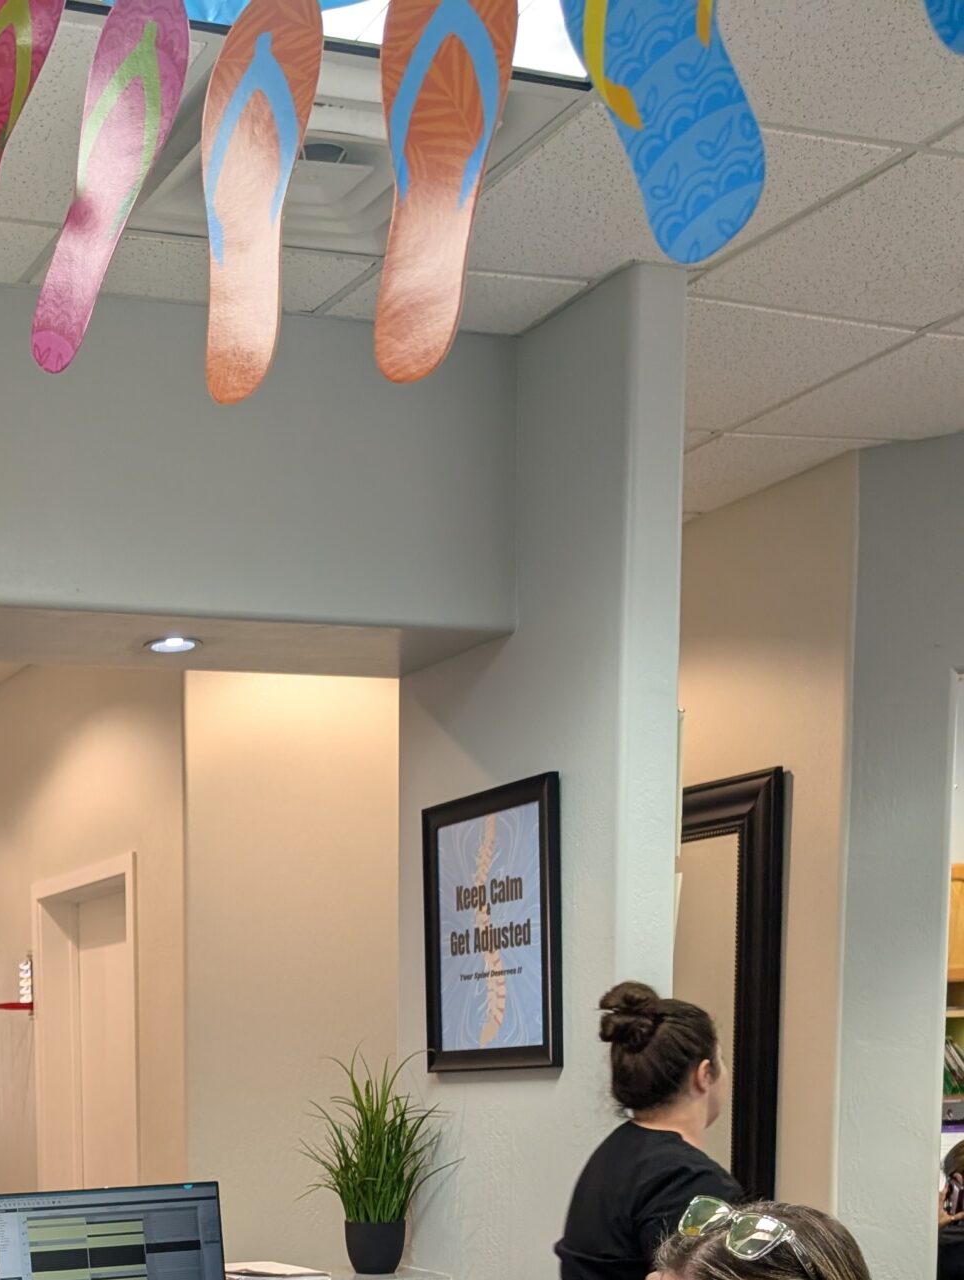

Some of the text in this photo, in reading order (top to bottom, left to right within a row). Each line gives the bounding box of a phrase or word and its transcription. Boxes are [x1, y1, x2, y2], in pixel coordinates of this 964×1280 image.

[455, 875, 523, 912] Keep Calm
[450, 918, 531, 957] Get Adjusted
